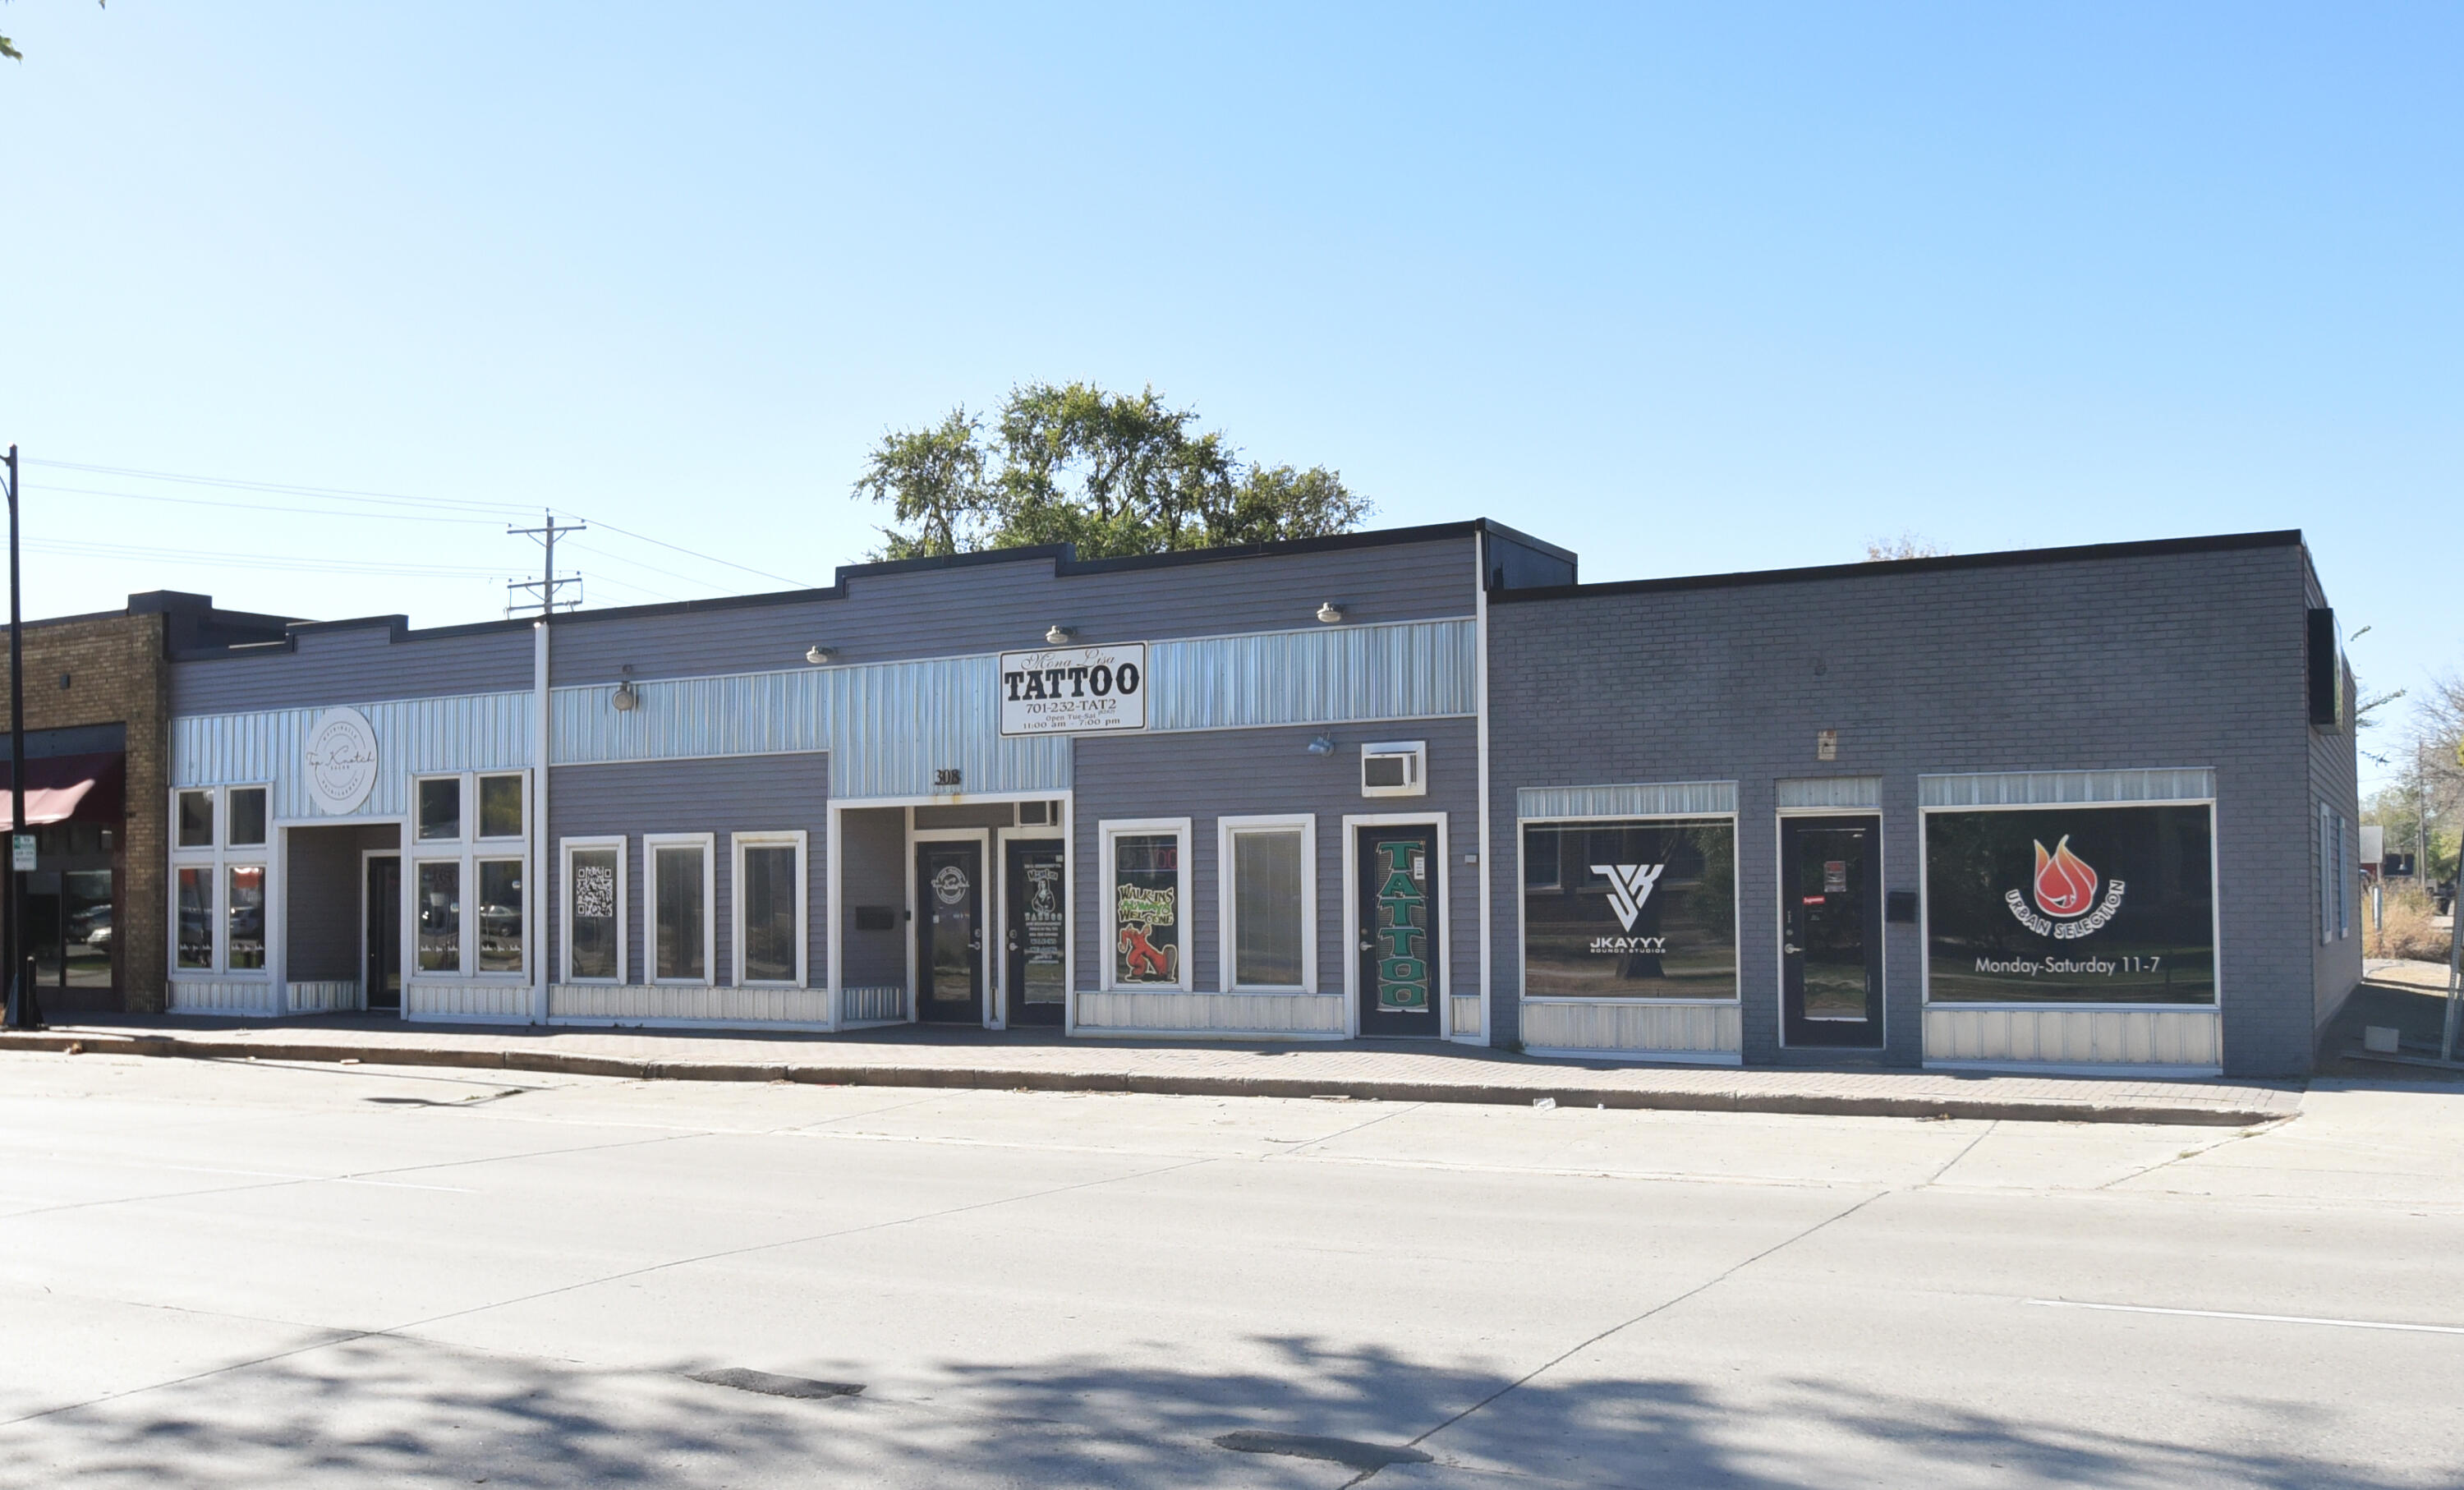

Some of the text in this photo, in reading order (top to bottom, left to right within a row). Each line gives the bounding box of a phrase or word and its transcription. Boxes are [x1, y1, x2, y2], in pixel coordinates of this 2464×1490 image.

[1021, 648, 1115, 670] Mona Lisa
[1004, 663, 1140, 701] TATTOO
[1027, 699, 1117, 714] 701-232-TAT2
[1023, 721, 1047, 729] 11:00
[1079, 719, 1101, 727] 7:00
[1106, 718, 1120, 727] pm
[934, 769, 960, 785] 308
[1118, 883, 1175, 905] WALK-INS
[1118, 909, 1175, 926] WELCOME
[2005, 879, 2126, 940] URBAN SELECTION
[1377, 841, 1427, 1008] TATTOO
[1590, 937, 1666, 948] JKAYYY
[1974, 956, 2161, 977] Monday-Saturday 11-7
